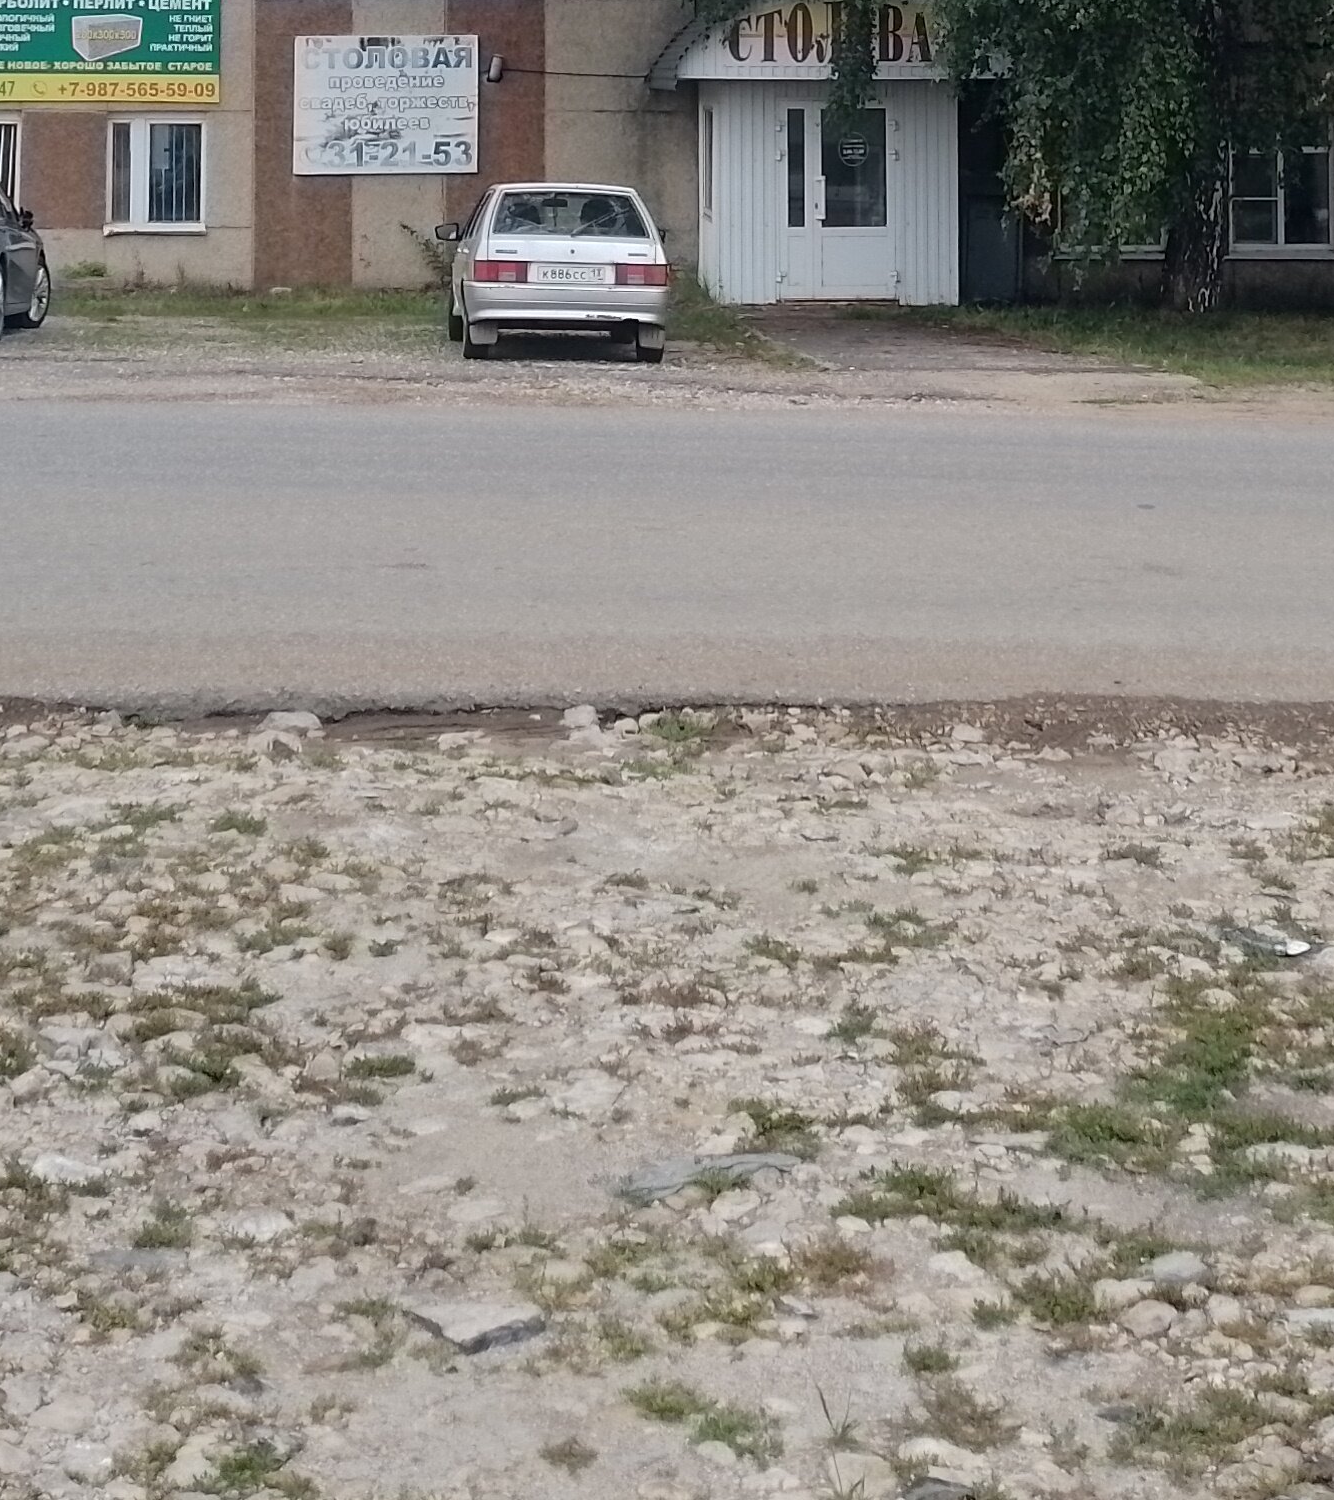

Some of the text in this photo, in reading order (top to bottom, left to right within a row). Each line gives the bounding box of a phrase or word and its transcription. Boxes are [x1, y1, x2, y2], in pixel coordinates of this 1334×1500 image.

[169, 14, 213, 23] НЕ ГНИЕТ
[173, 23, 213, 32] ТЕПЛЫЙ
[168, 34, 213, 42] НЕ ГОРИТ
[149, 43, 213, 52] ПРАКТИЧНЫЙ
[301, 47, 473, 69] СТОЛОВАЯ
[54, 61, 104, 71] ХОРОШО
[107, 61, 162, 71] ЗАБЫТОЕ
[168, 62, 213, 71] СТАРОЕ
[58, 82, 215, 98] +7-987-565-59-09
[328, 75, 445, 92] проведение
[299, 93, 475, 112] свадеб, торжеств,
[343, 115, 430, 130] юбилеев
[327, 140, 473, 168] 31-21-53
